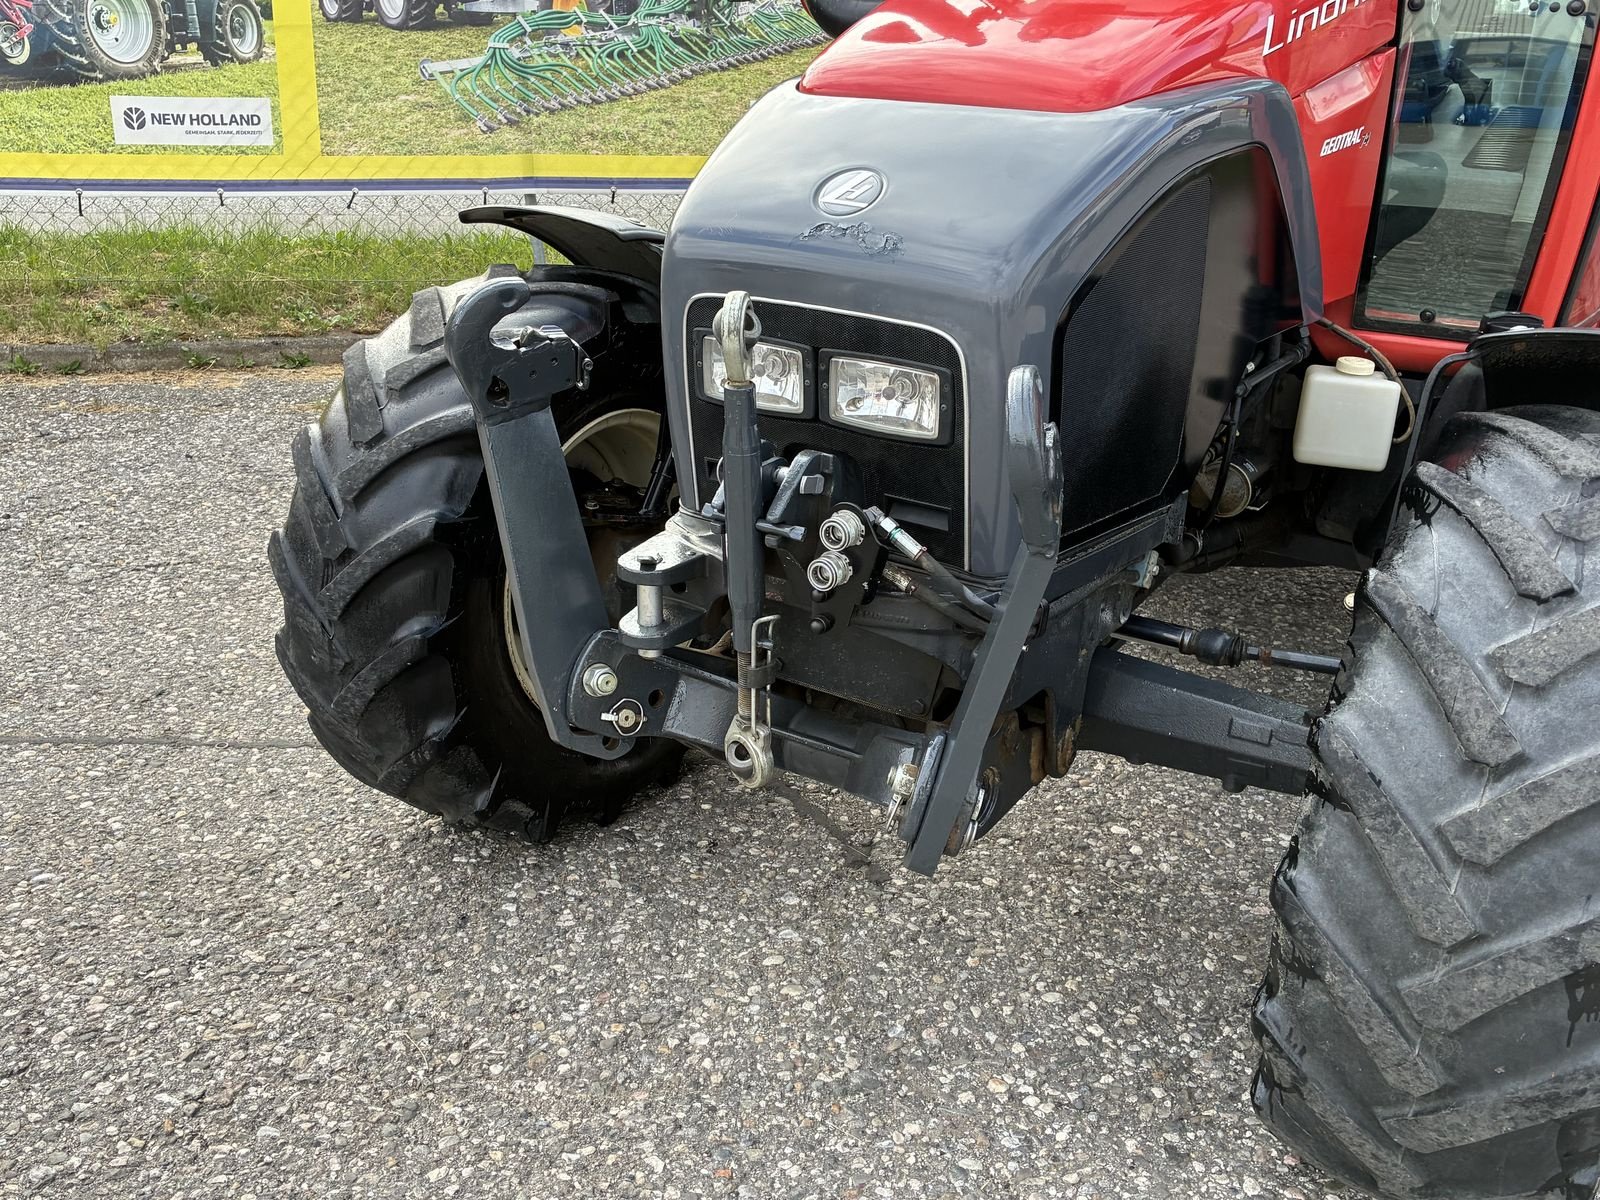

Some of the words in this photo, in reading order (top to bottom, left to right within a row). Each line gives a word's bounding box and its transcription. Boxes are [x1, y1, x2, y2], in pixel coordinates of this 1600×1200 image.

[1262, 0, 1367, 57] Lind
[150, 112, 186, 126] NEW
[189, 113, 262, 126] HOLLAND
[1319, 126, 1365, 157] GEOTRAC
